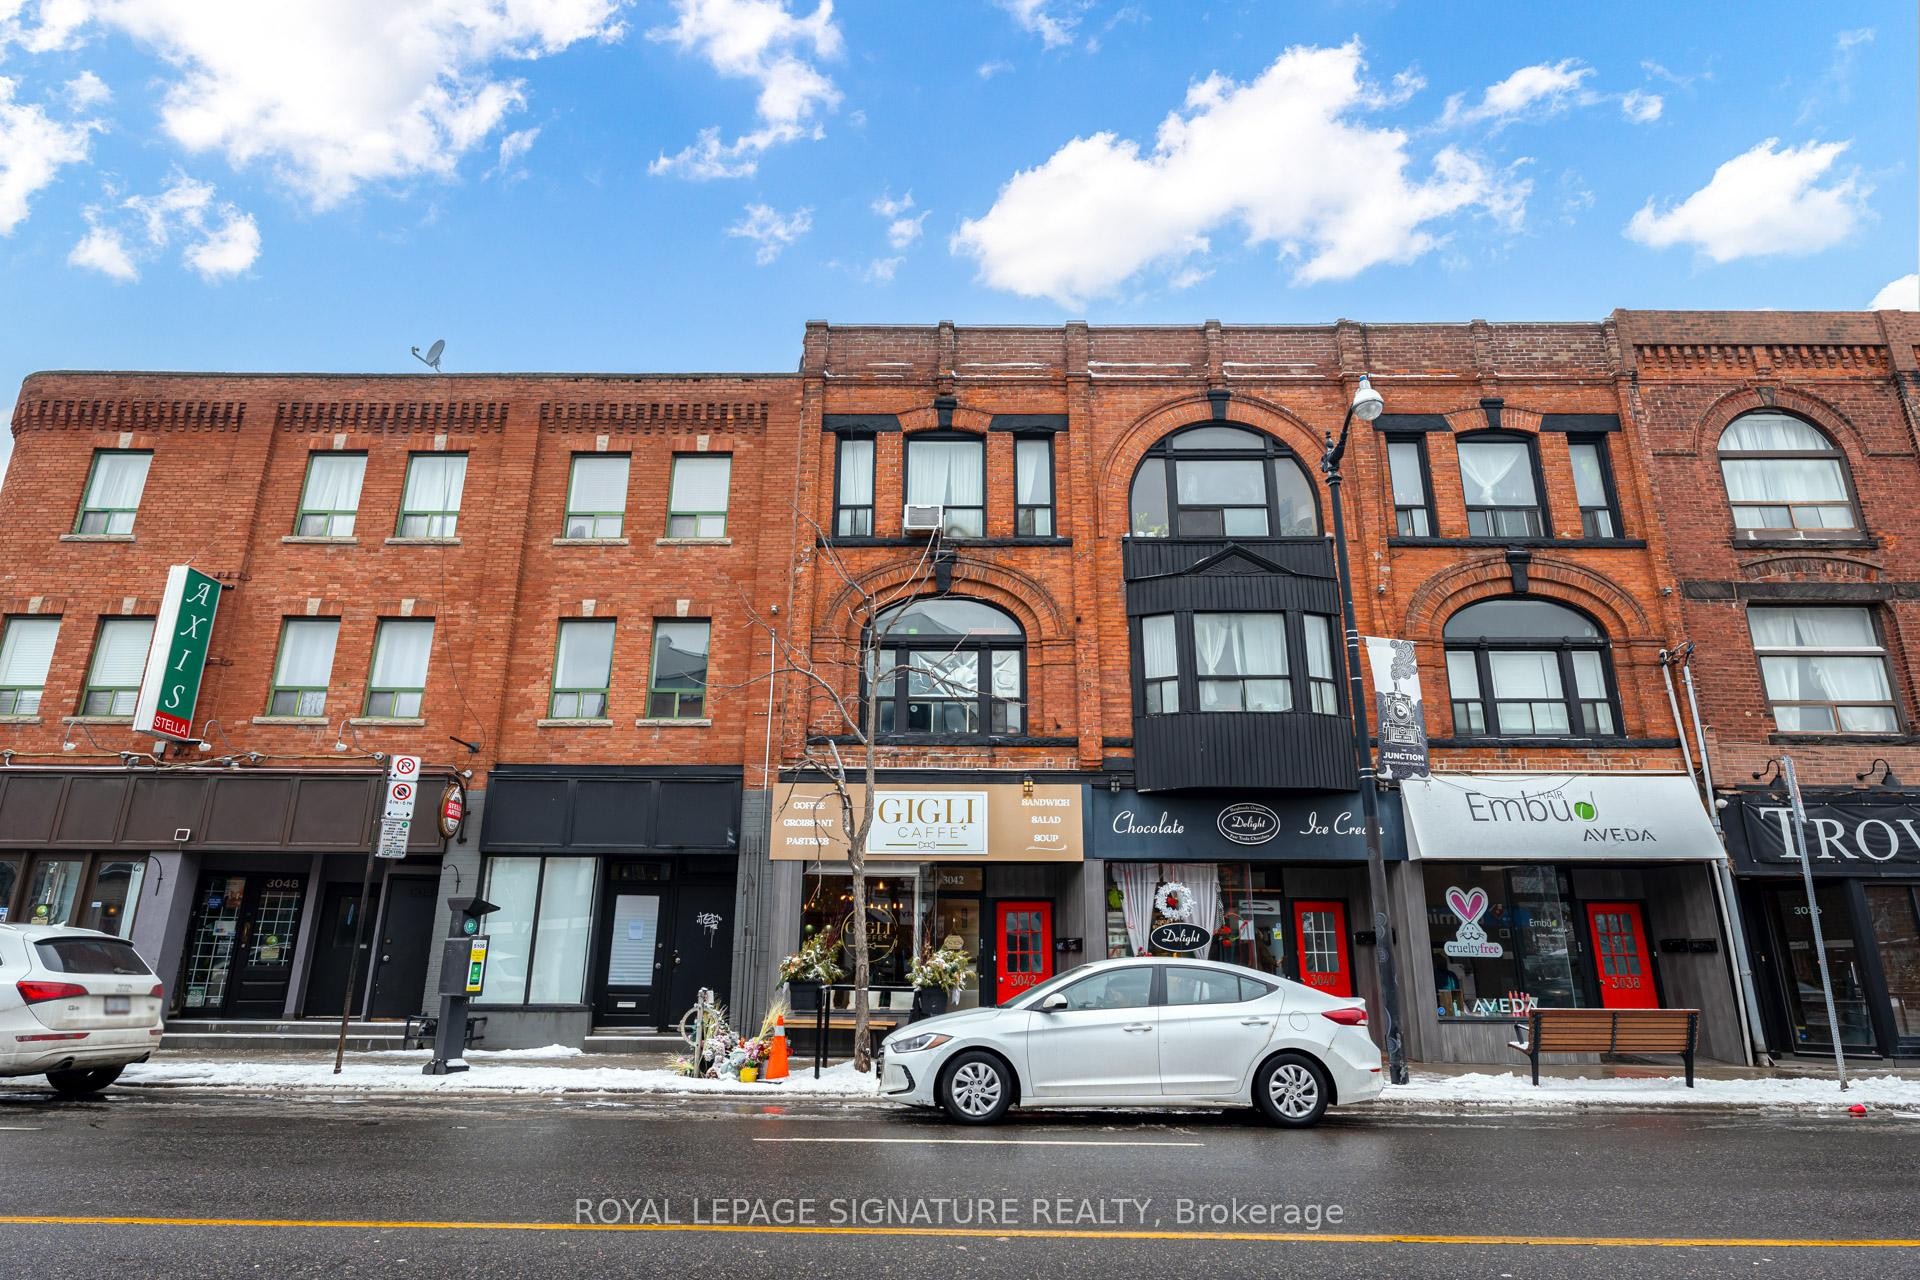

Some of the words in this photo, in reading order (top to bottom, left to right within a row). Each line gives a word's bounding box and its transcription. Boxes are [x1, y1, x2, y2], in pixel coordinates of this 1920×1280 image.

[165, 582, 211, 709] AXIS
[154, 715, 187, 736] STELLA
[1383, 752, 1424, 762] JUNCTION
[1537, 790, 1565, 800] HAIR
[793, 801, 826, 810] COFFEE
[1021, 798, 1071, 807] SANDWICH
[878, 798, 975, 824] GIGLI
[1031, 815, 1061, 824] SALAD
[1112, 810, 1185, 834] Chocolate
[1231, 815, 1266, 831] Delight
[1300, 811, 1329, 835] Ice
[1334, 811, 1385, 835] Cre
[1033, 834, 1059, 842] SOUP
[1583, 828, 1657, 842] AVEDA
[266, 880, 299, 889] 3048
[942, 875, 965, 885] 3042
[1794, 906, 1823, 915] 306
[845, 921, 891, 935] GGLI
[1161, 928, 1200, 946] Delight
[1011, 974, 1037, 987] 3042
[1310, 974, 1336, 986] 3040
[1612, 978, 1641, 989] 3038
[1473, 998, 1538, 1013] AVEDA
